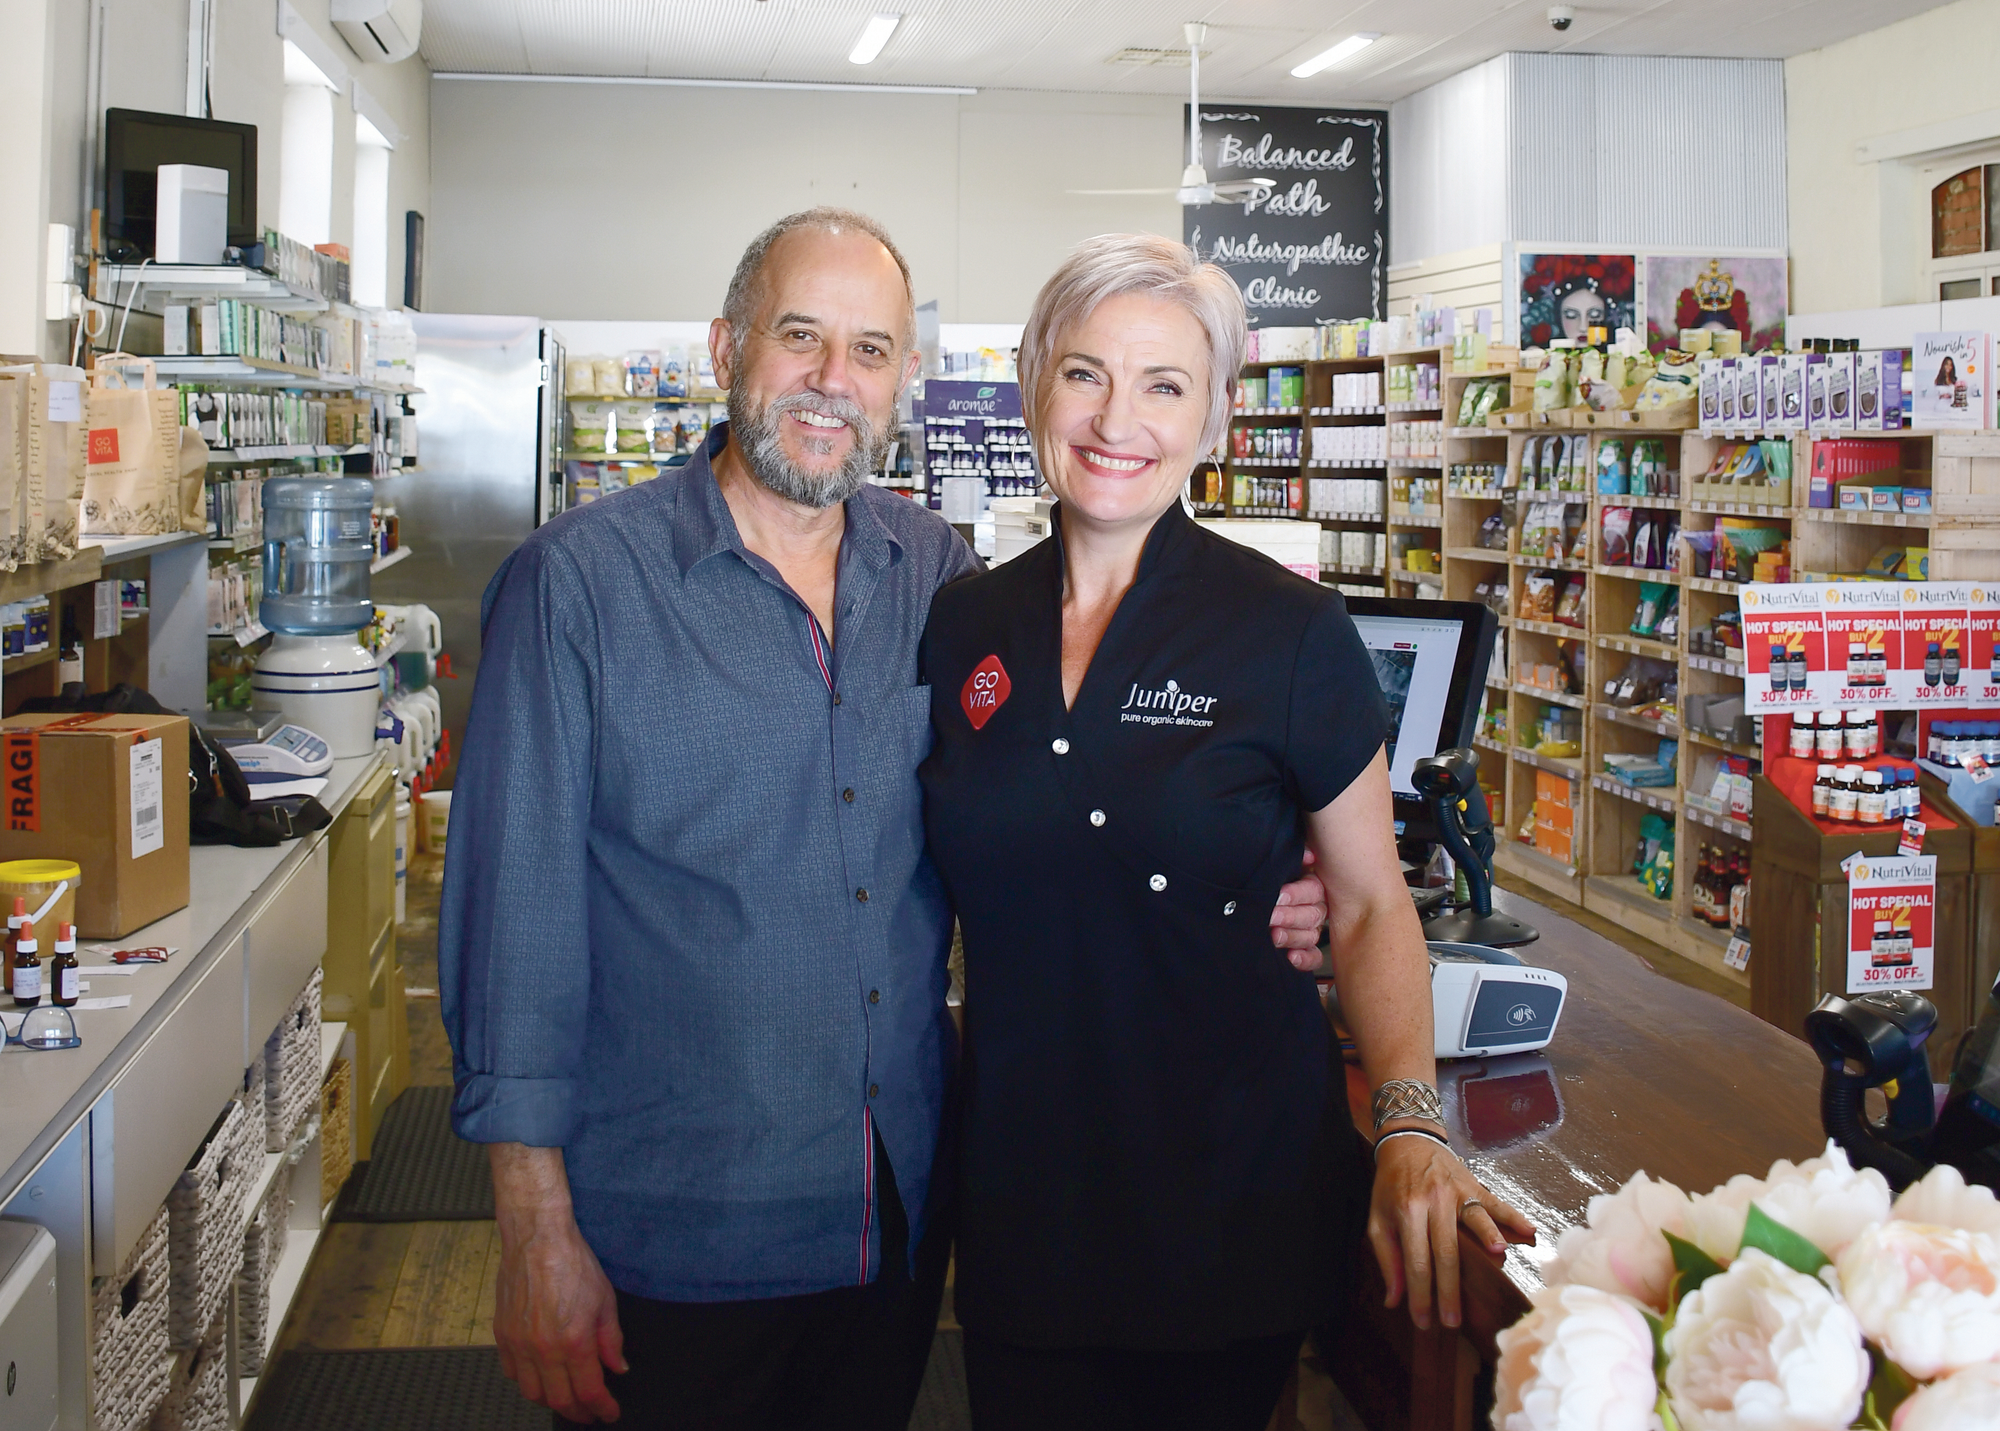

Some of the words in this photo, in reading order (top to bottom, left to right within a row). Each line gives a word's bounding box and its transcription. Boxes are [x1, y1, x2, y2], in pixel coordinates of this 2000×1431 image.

[1218, 132, 1356, 170] Balanced
[1245, 178, 1331, 215] Path
[1211, 232, 1370, 276] Naturopathic
[1246, 275, 1321, 306] Clinic
[1924, 335, 1965, 357] Nourish
[1967, 337, 1976, 362] 5
[95, 437, 110, 446] GO
[94, 447, 113, 455] VITA
[1761, 589, 1819, 605] NutriVital
[1842, 588, 1899, 604] NutriVital
[1747, 622, 1770, 633] HOT
[1772, 620, 1823, 633] SPECIAL
[1828, 620, 1851, 632] HOT
[1853, 618, 1901, 631] SPECIAL
[1905, 619, 1927, 631] HOT
[1972, 620, 1994, 631] HOT
[1768, 634, 1787, 645] BUY
[1787, 630, 1805, 652] 2
[1849, 632, 1867, 643] BUY
[1867, 628, 1885, 649] 2
[1925, 631, 1943, 642] BUY
[1942, 628, 1960, 649] 2
[974, 671, 999, 689] GO
[969, 690, 996, 709] VITA
[1121, 679, 1217, 716] Juniper
[1761, 690, 1787, 702] 30%
[1791, 689, 1814, 701] OFF
[1840, 688, 1866, 699] 30%
[1869, 687, 1892, 699] OFF
[1916, 686, 1941, 698] 30%
[1944, 686, 1967, 698] OFF
[1121, 712, 1141, 723] pure
[1142, 714, 1175, 726] organic
[1175, 717, 1214, 728] skincare
[1872, 863, 1932, 880] NutriVital
[1853, 896, 1879, 909] HOT
[1879, 894, 1932, 909] SPECIAL
[1874, 909, 1894, 920] BUY
[1893, 905, 1911, 927] 2
[1864, 968, 1891, 981] 30%
[1894, 966, 1919, 979] OFF
